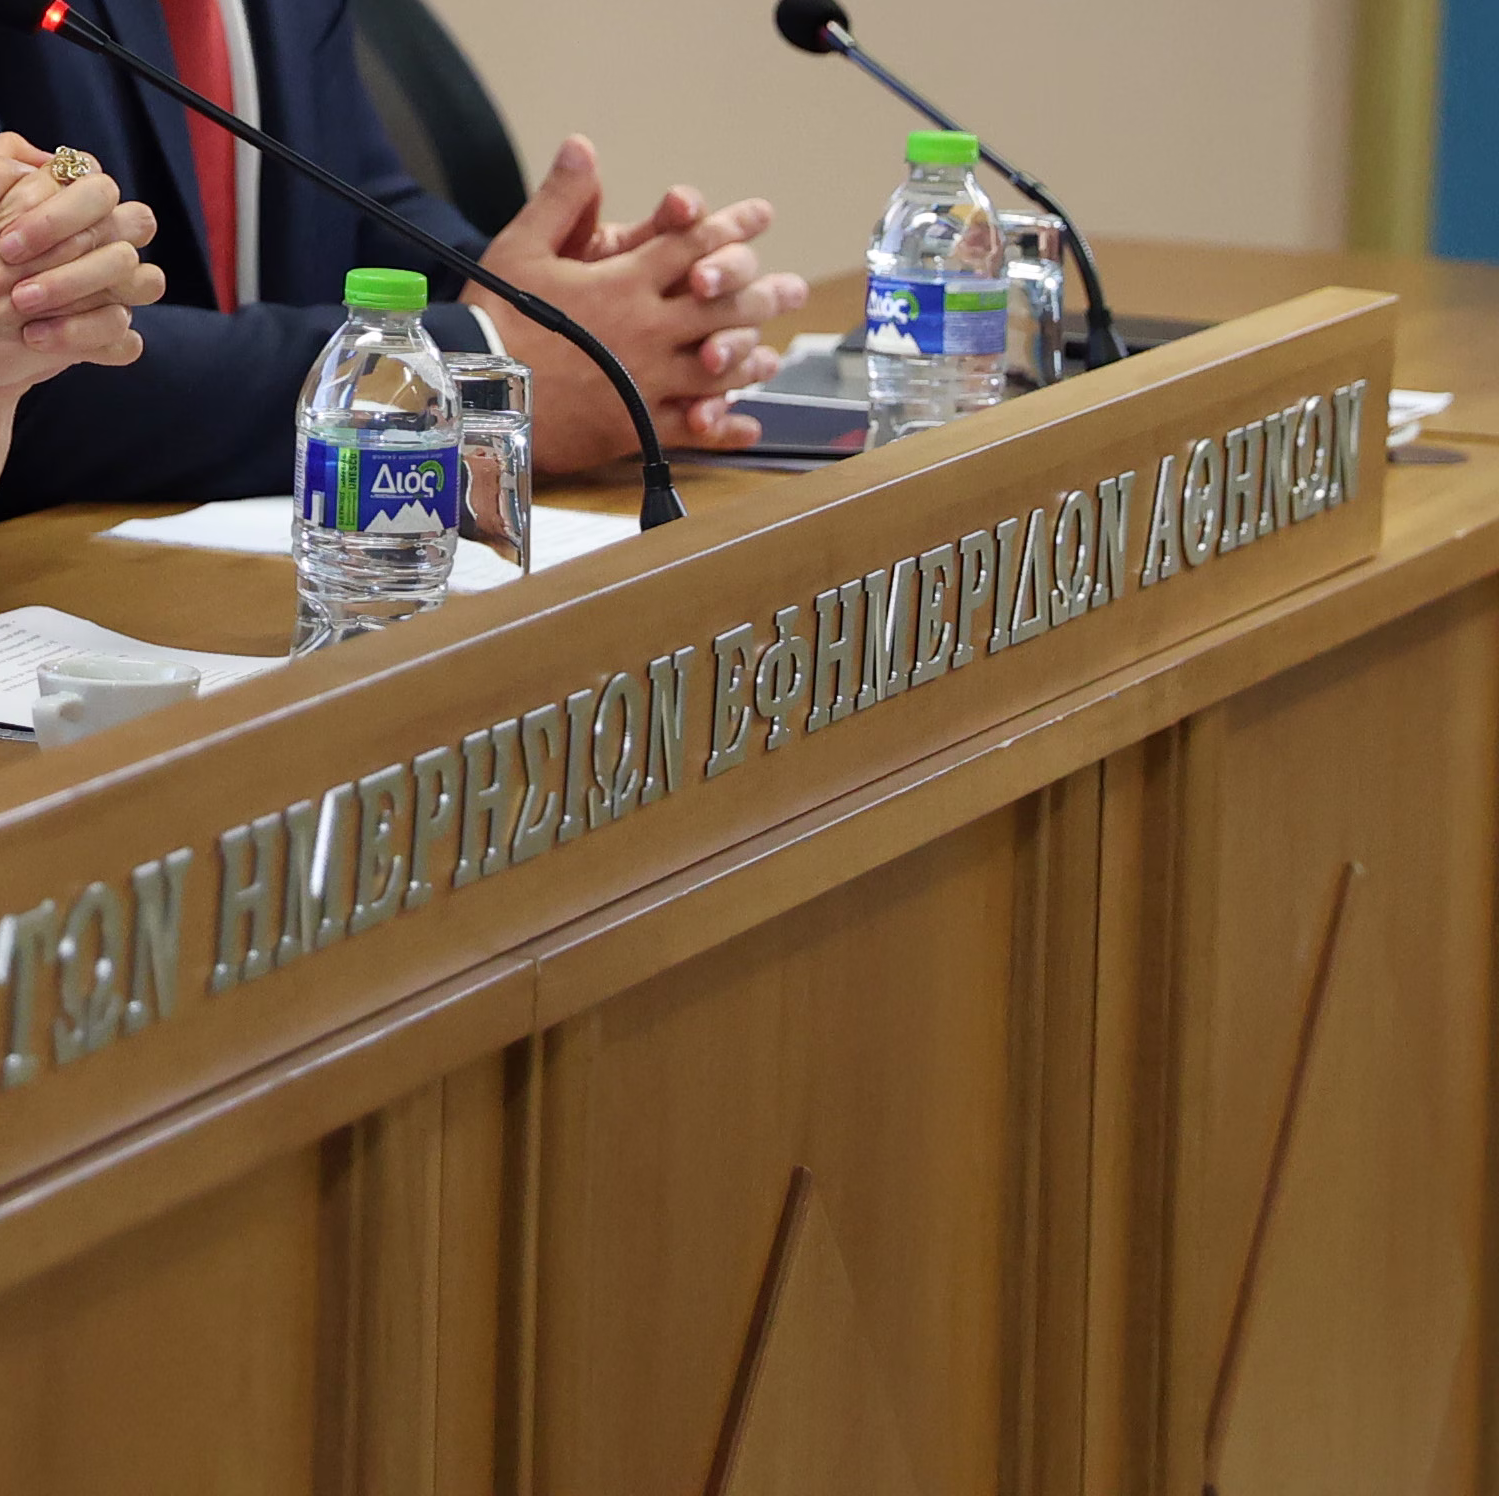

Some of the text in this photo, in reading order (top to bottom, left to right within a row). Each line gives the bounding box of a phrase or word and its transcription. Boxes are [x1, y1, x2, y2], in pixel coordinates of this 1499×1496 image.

[370, 463, 436, 498] Διός
[211, 645, 695, 992] ΗΜΕΡΗΣΙΩΝ
[706, 470, 1135, 779] ΕΦΗΜΕΡΙΔΩΝ
[1141, 379, 1367, 586] ΑΘΗΝΩΝ
